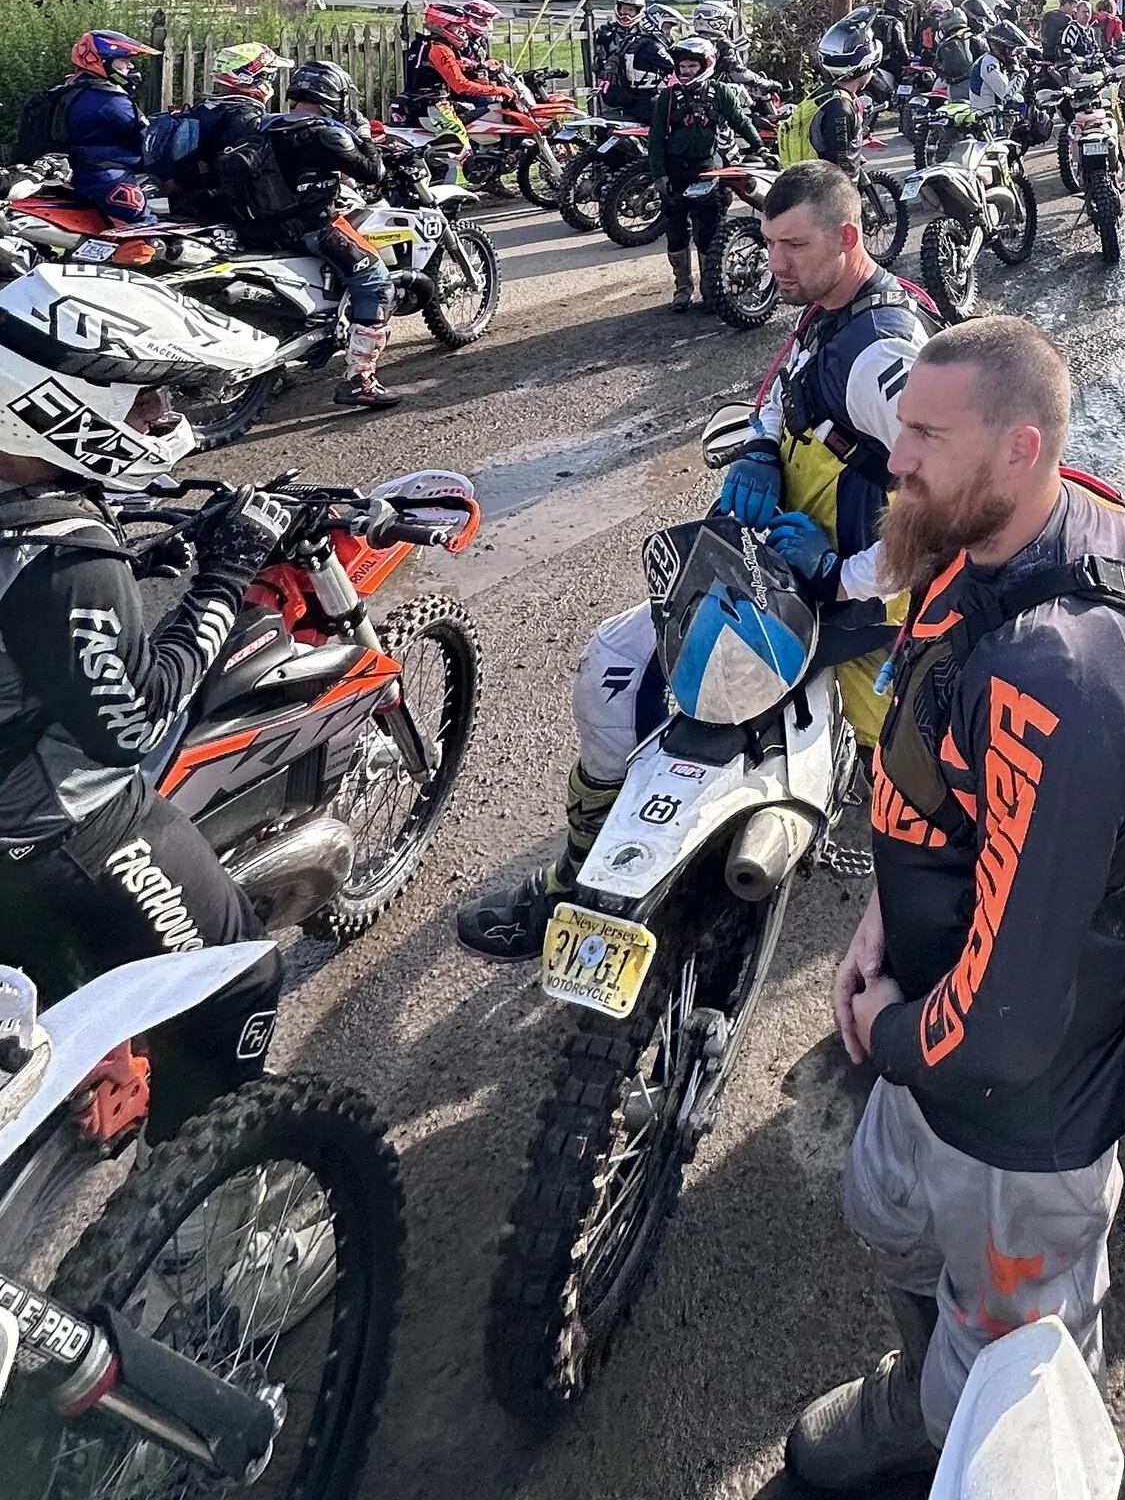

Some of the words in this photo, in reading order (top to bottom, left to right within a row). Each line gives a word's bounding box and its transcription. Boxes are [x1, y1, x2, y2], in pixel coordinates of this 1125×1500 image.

[10, 380, 147, 477] FXR
[350, 558, 377, 585] RIVAL
[670, 763, 706, 780] 100%
[568, 909, 600, 932] New
[599, 922, 639, 946] Jersey
[546, 974, 613, 1005] MOTORCYCLE
[32, 1306, 89, 1361] PRO
